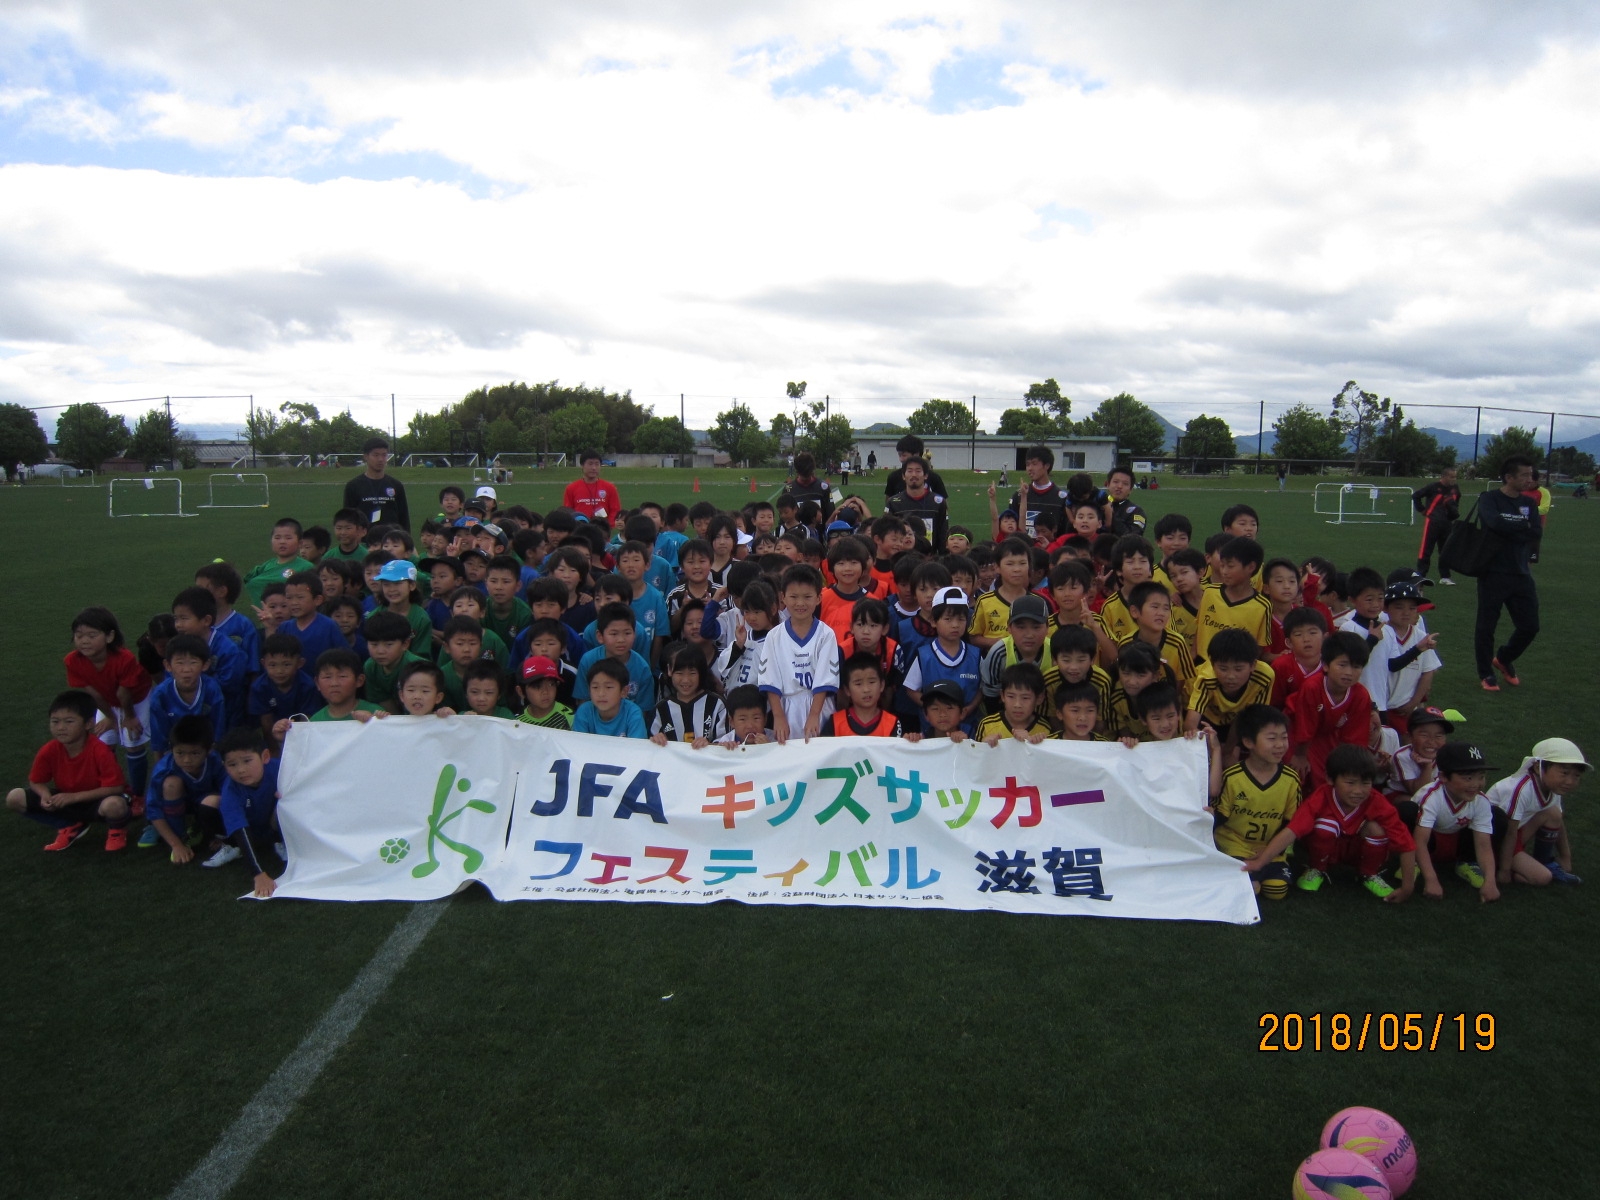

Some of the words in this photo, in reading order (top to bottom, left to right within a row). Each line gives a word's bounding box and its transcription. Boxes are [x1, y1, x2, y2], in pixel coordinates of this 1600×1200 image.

[794, 672, 814, 690] 70
[530, 758, 669, 825] JFA
[701, 758, 1106, 831] キッズサッカー
[1244, 822, 1268, 841] 21
[528, 841, 941, 886] フェスティバル
[974, 846, 1114, 902] 滋賀
[1382, 1134, 1411, 1169] molte
